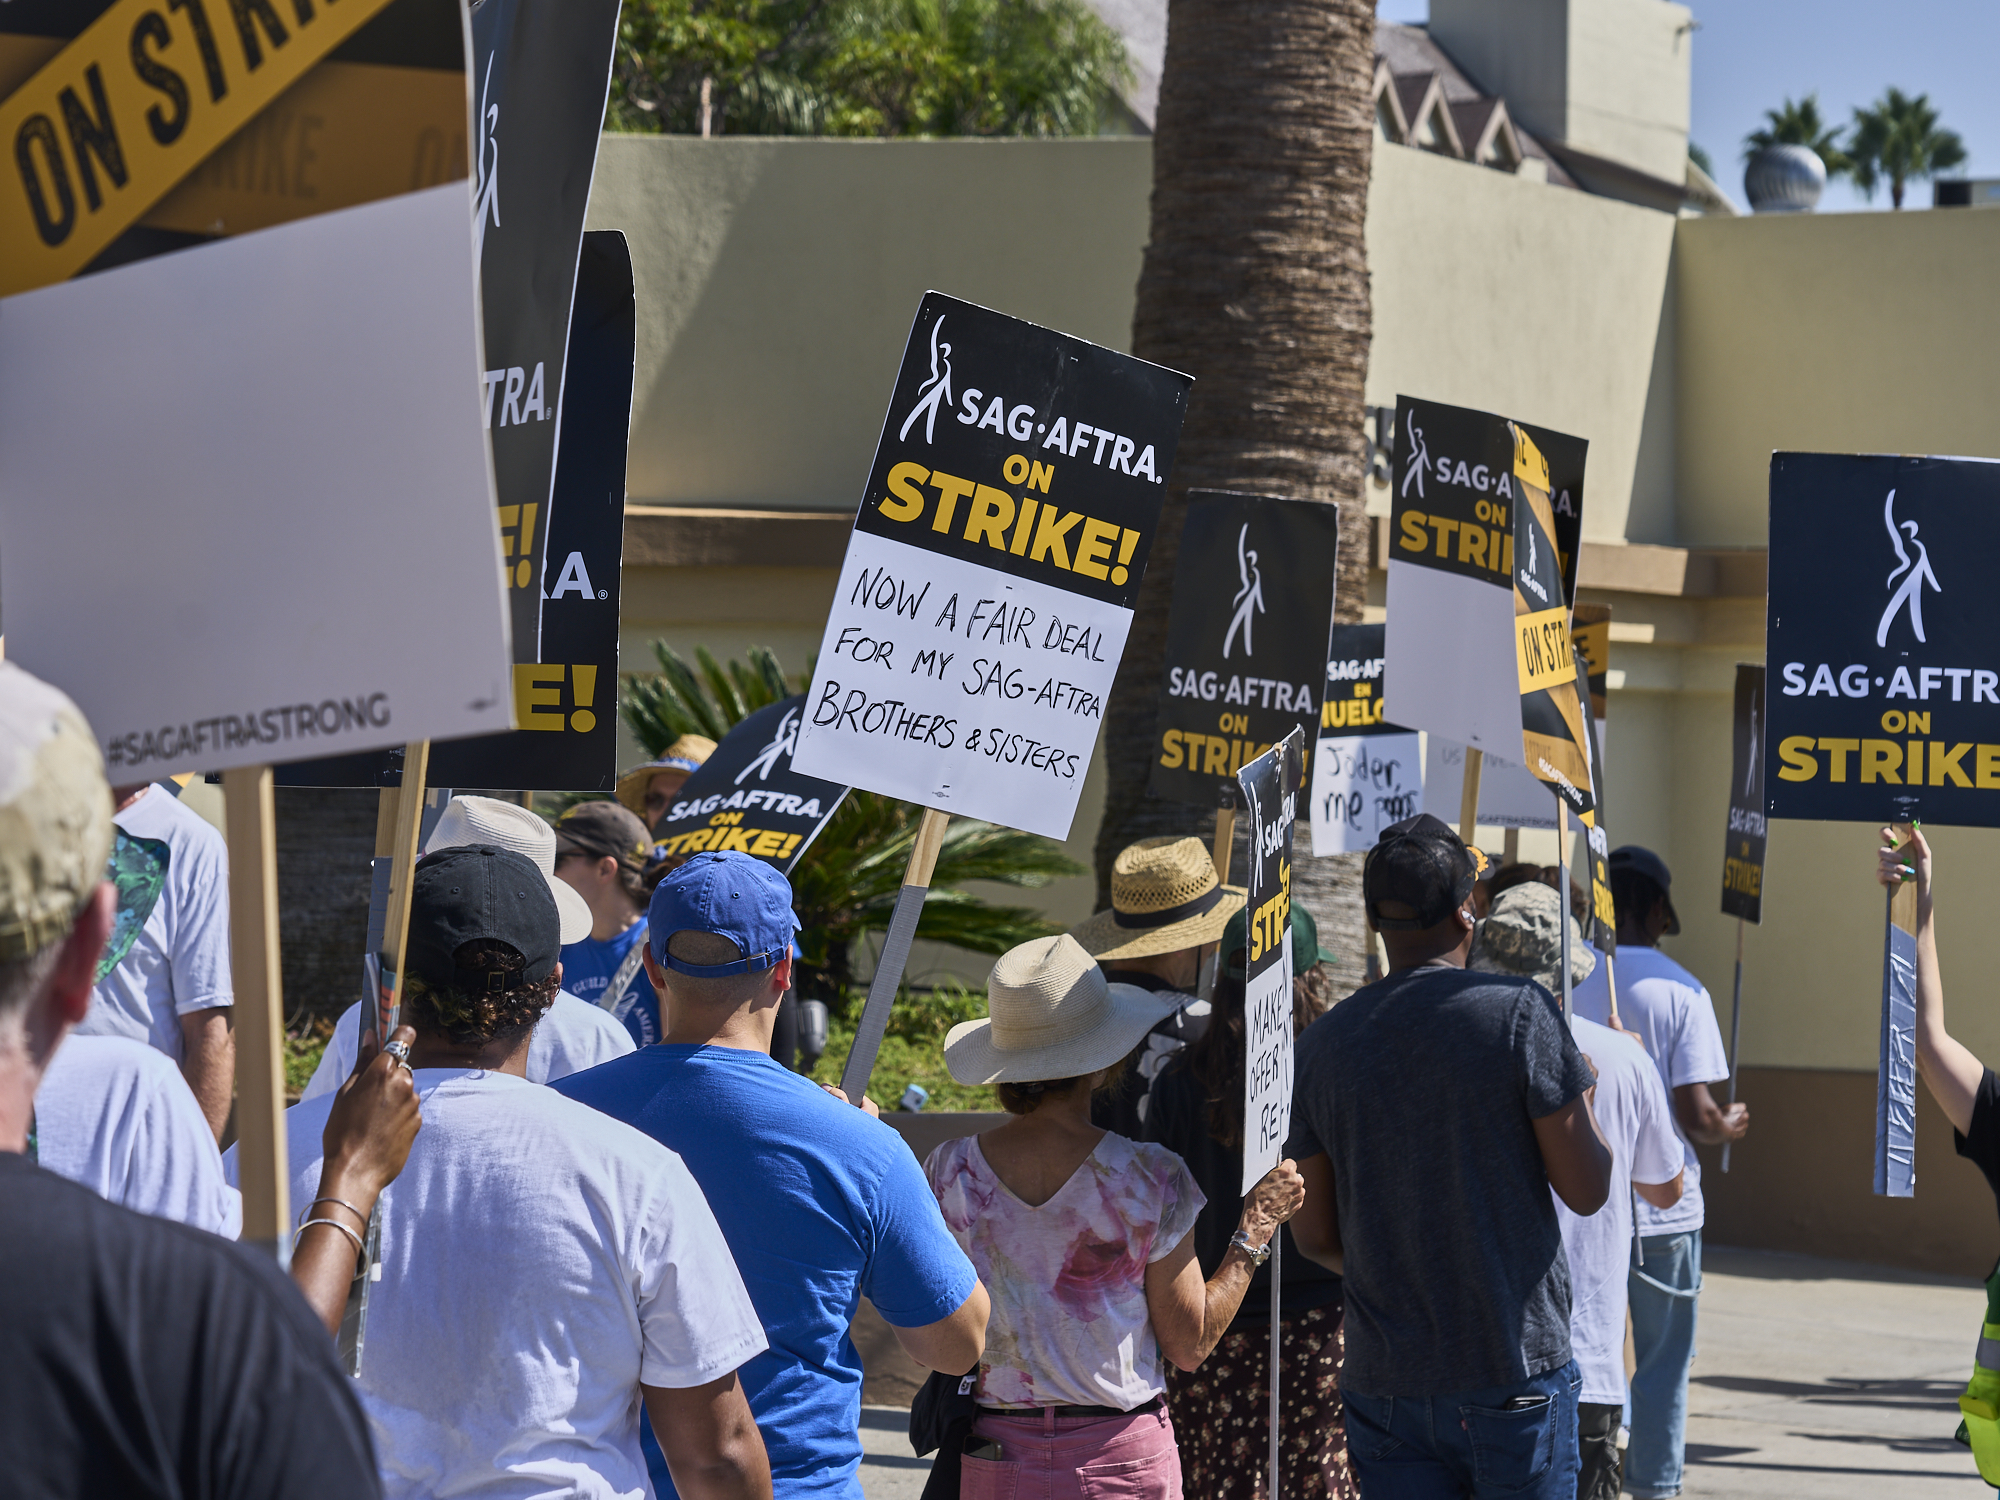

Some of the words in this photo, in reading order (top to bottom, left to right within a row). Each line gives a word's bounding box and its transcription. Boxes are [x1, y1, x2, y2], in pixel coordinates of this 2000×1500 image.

[14, 63, 129, 247] ON
[130, 0, 352, 147] STR
[957, 387, 1157, 484] SAG·AFTRA
[1003, 454, 1055, 494] ON
[878, 461, 1141, 586] STRIKE!
[1475, 499, 1507, 528] ON
[851, 567, 931, 620] NOW
[935, 593, 958, 632] A
[967, 599, 1036, 648] FAIR
[1042, 615, 1105, 662] DEAL
[835, 627, 894, 670] FOR
[911, 649, 955, 680] MY
[962, 658, 1100, 719] SAG-AFTRA
[1326, 657, 1386, 682] SAG·AF
[1522, 624, 1545, 677] ON
[1168, 666, 1314, 715] SAG·AFTRA
[1782, 662, 2000, 704] SAG·AFTR
[107, 691, 391, 768] #SAGAFTRASTRONG
[812, 680, 958, 749] BROTHERS
[984, 728, 1080, 778] SISTERS
[1218, 712, 1249, 736] ON
[1881, 710, 1931, 735] ON
[1159, 728, 1310, 789] STRI!
[1778, 736, 2000, 789] STRIKE
[709, 812, 745, 827] ON
[572, 976, 609, 994] GUILD
[633, 1007, 655, 1046] AMER
[1251, 985, 1283, 1053] MAKE
[1250, 1042, 1279, 1103] OFFER
